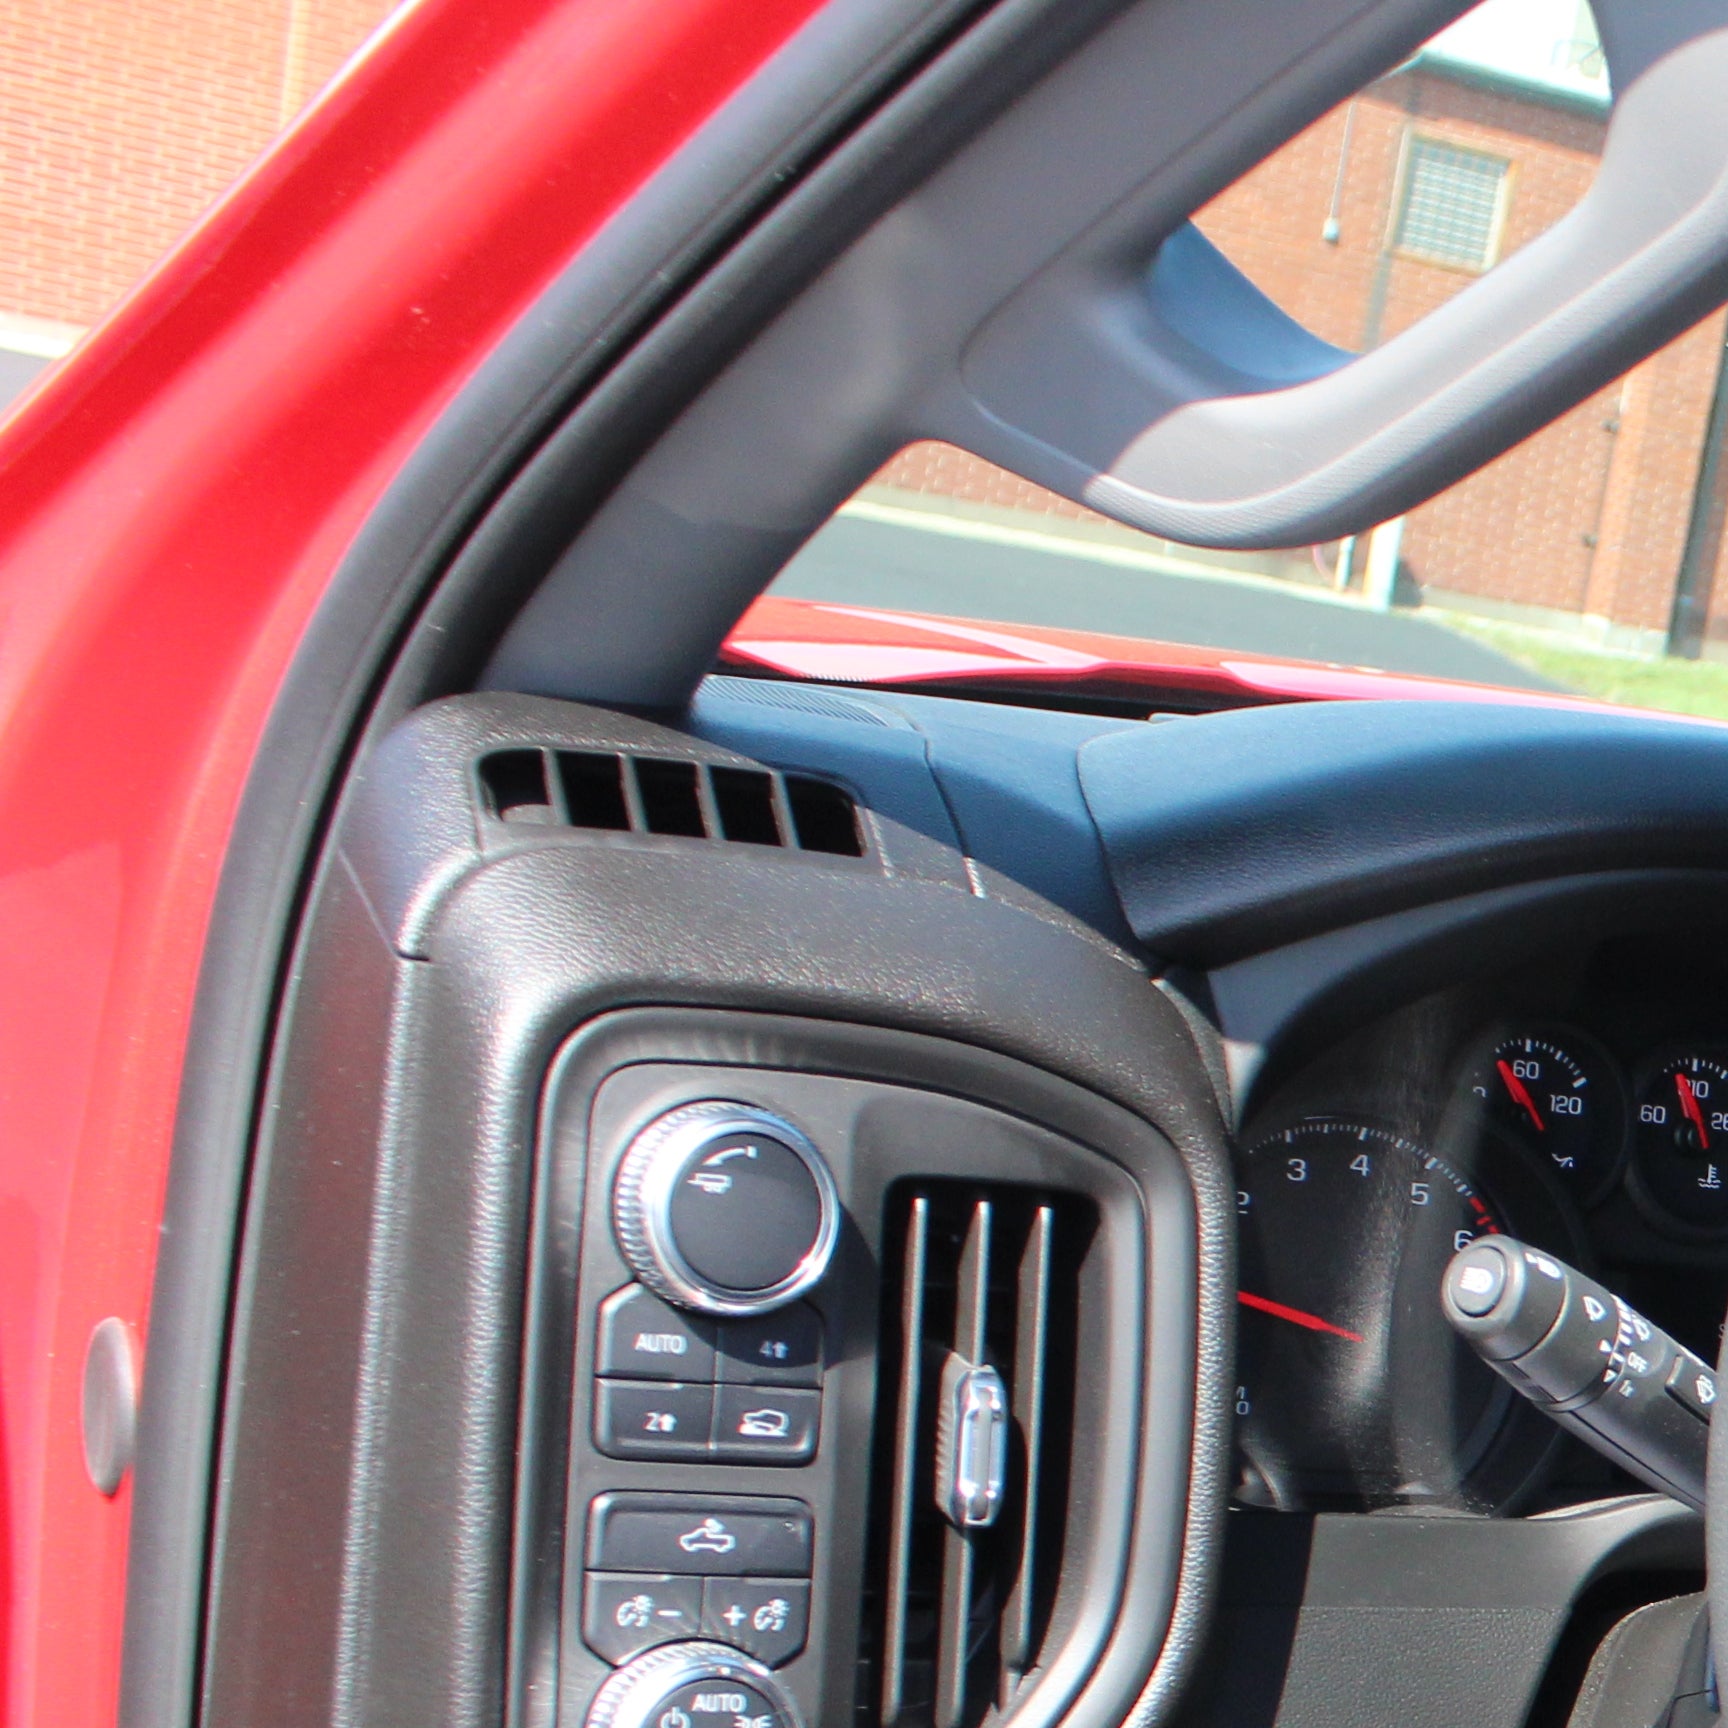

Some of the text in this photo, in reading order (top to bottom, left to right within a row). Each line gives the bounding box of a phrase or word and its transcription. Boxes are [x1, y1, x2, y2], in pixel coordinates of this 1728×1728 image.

[1512, 1059, 1541, 1080] 60
[1684, 1079, 1710, 1099] 10
[1549, 1094, 1583, 1116] 120
[1286, 1157, 1307, 1182] 3
[1350, 1154, 1370, 1177] 4
[1410, 1182, 1430, 1206] 5
[634, 1332, 688, 1355] AUTO
[690, 1693, 749, 1715] AUTO
